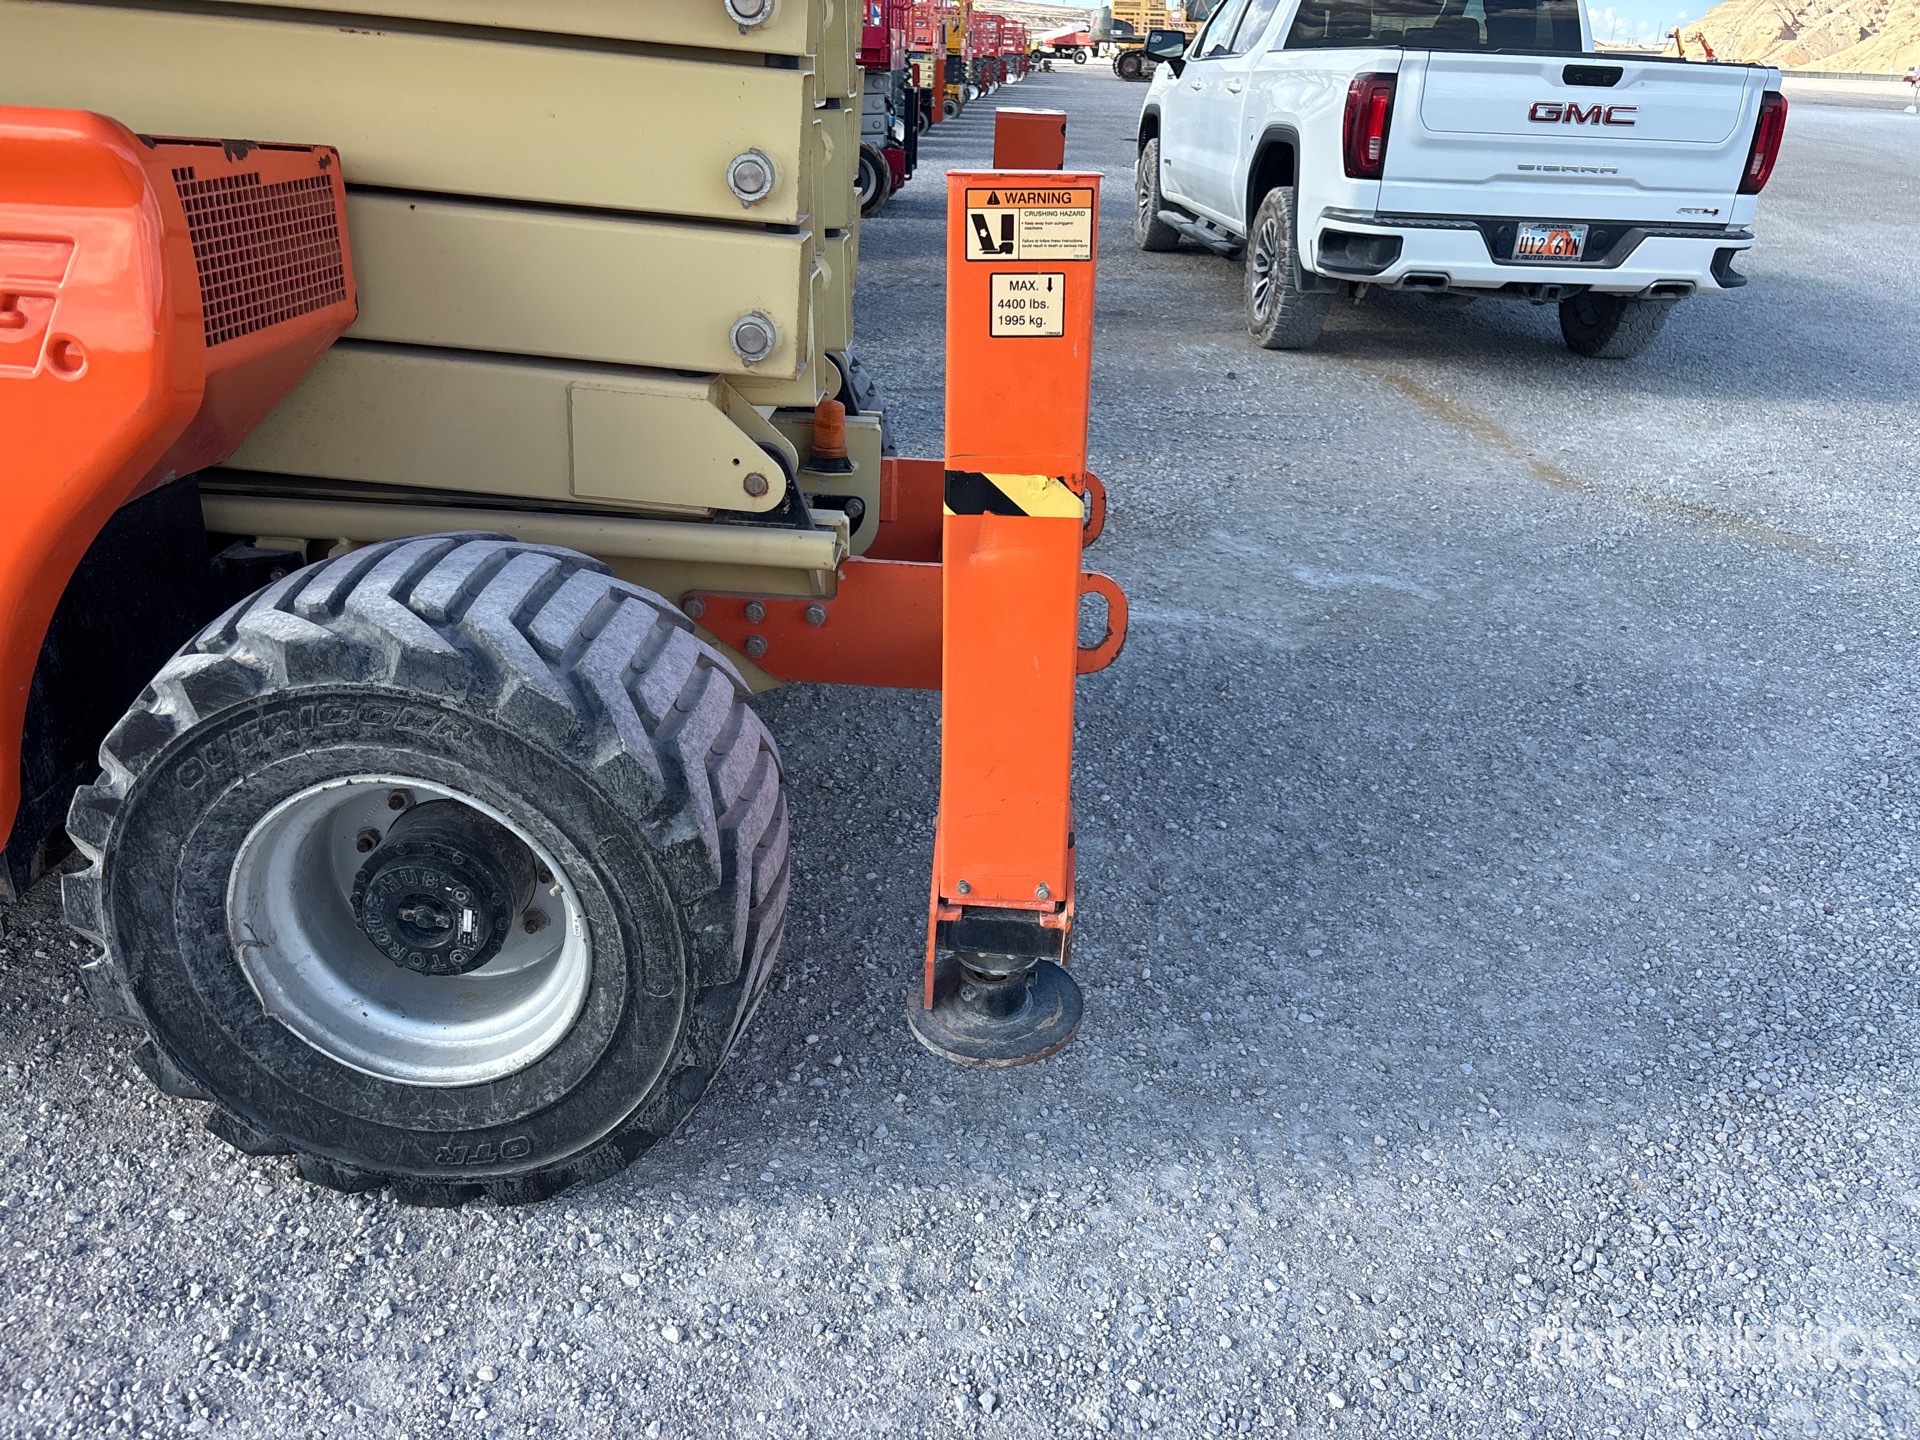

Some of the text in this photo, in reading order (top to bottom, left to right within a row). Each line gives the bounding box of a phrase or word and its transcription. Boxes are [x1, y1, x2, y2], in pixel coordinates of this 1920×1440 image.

[1528, 101, 1639, 127] GMC
[1517, 164, 1618, 175] SIERRA
[1004, 192, 1072, 204] WARNING
[1554, 237, 1581, 255] 6YN
[1009, 280, 1039, 291] MAX.
[997, 298, 1050, 309] 4400 lbs.
[998, 315, 1047, 328] 1995 kg.
[175, 702, 473, 791] OUTRIGGER
[435, 1135, 530, 1165] OTR
